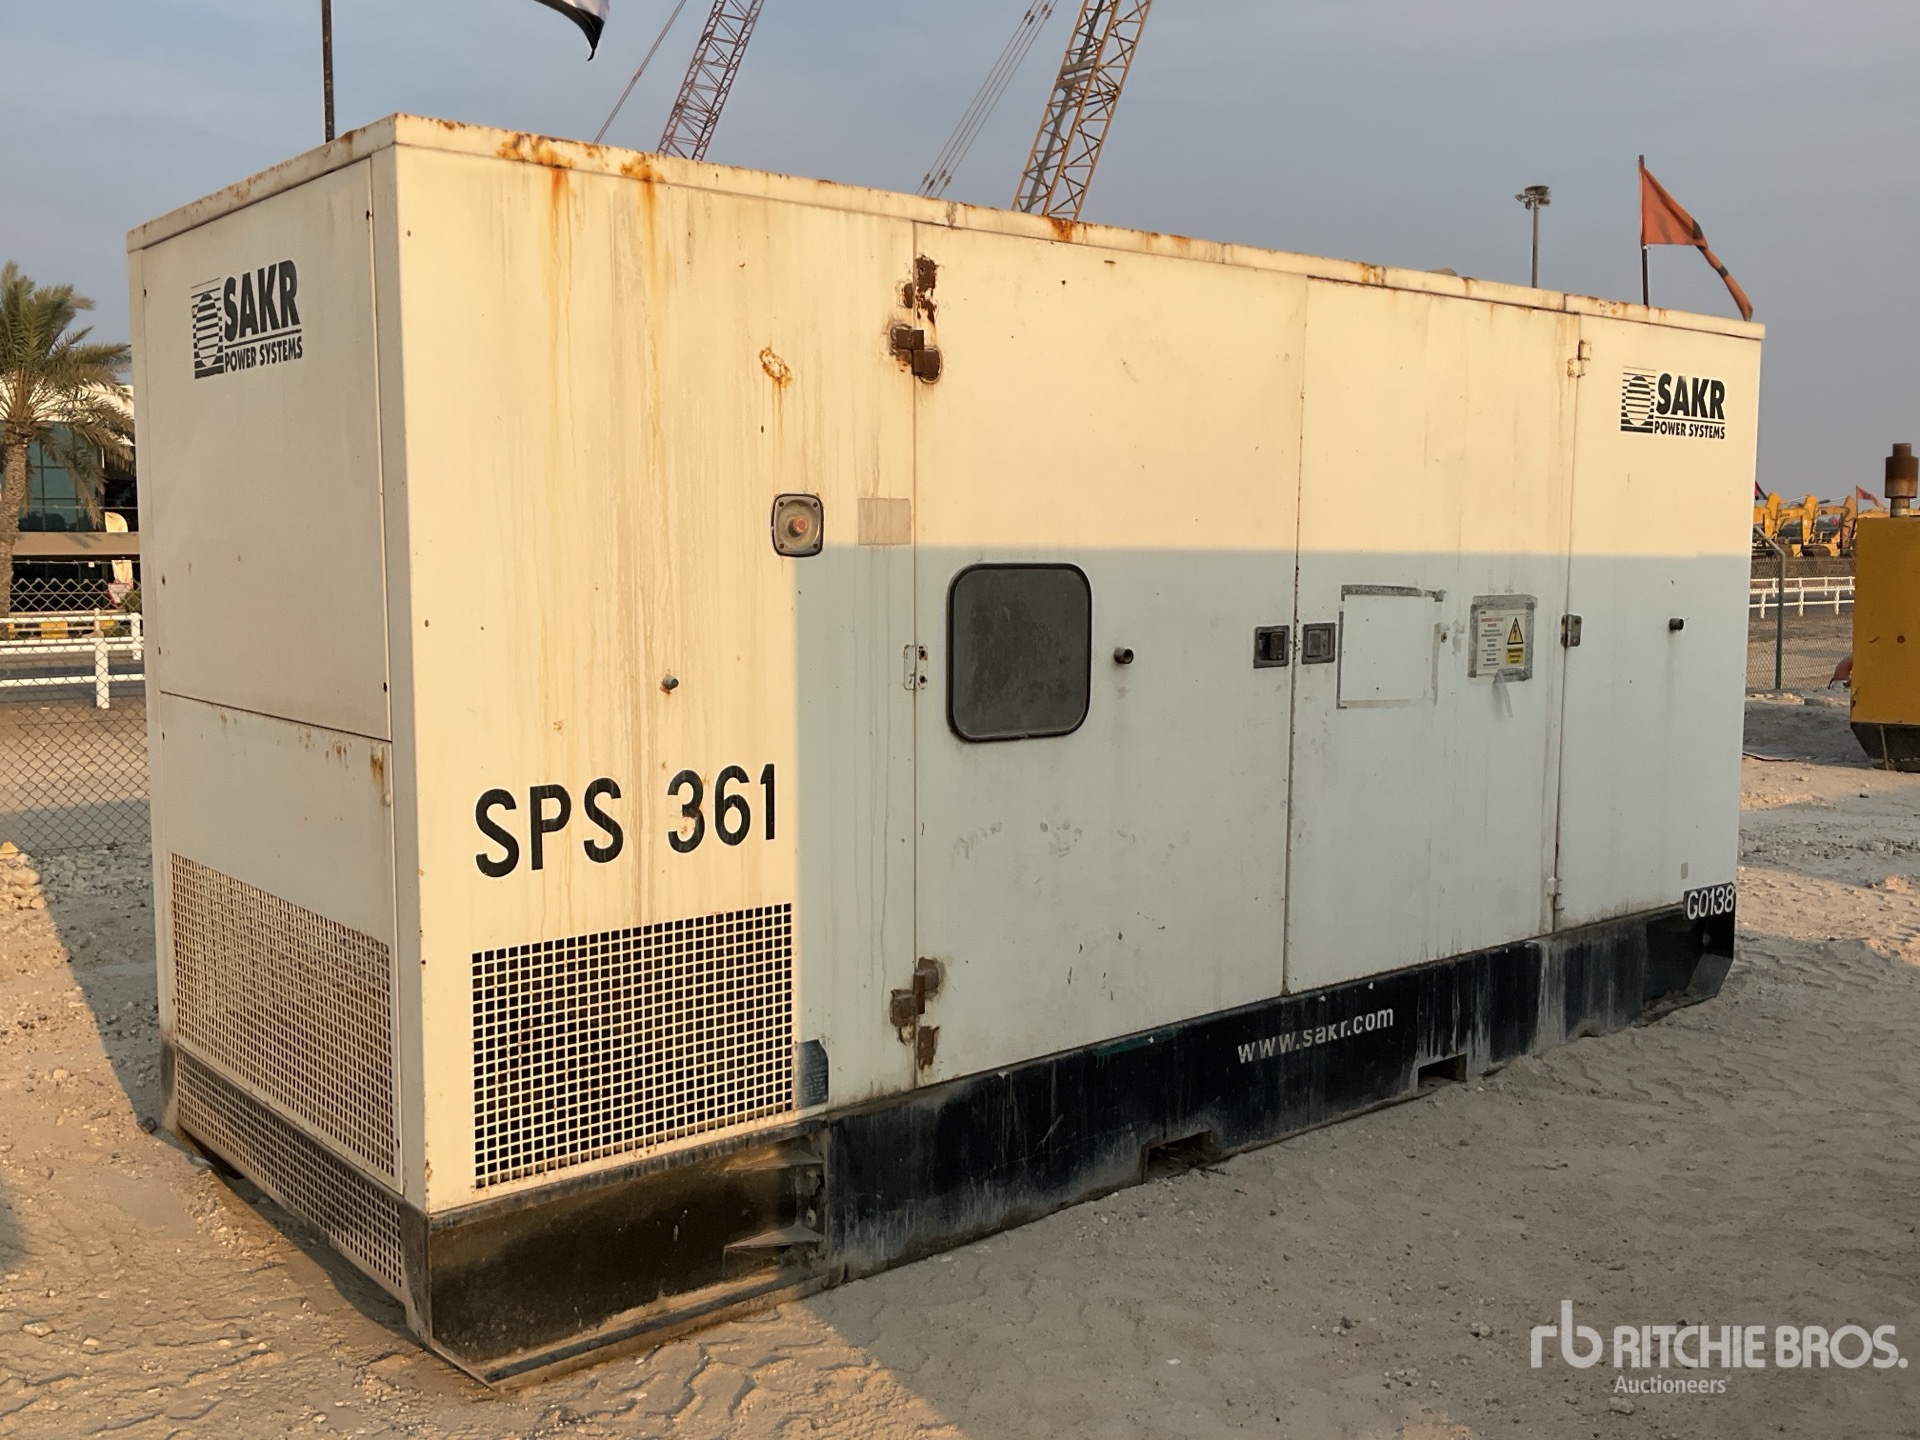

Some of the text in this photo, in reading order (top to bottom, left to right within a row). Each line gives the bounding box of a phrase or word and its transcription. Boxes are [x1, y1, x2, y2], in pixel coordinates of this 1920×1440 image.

[223, 259, 301, 342] SAKR
[224, 335, 303, 373] POWER SYSTEMS
[1655, 372, 1725, 420] SAKR
[1654, 420, 1725, 440] POWER SYSTEMS
[475, 763, 775, 878] SPS 361
